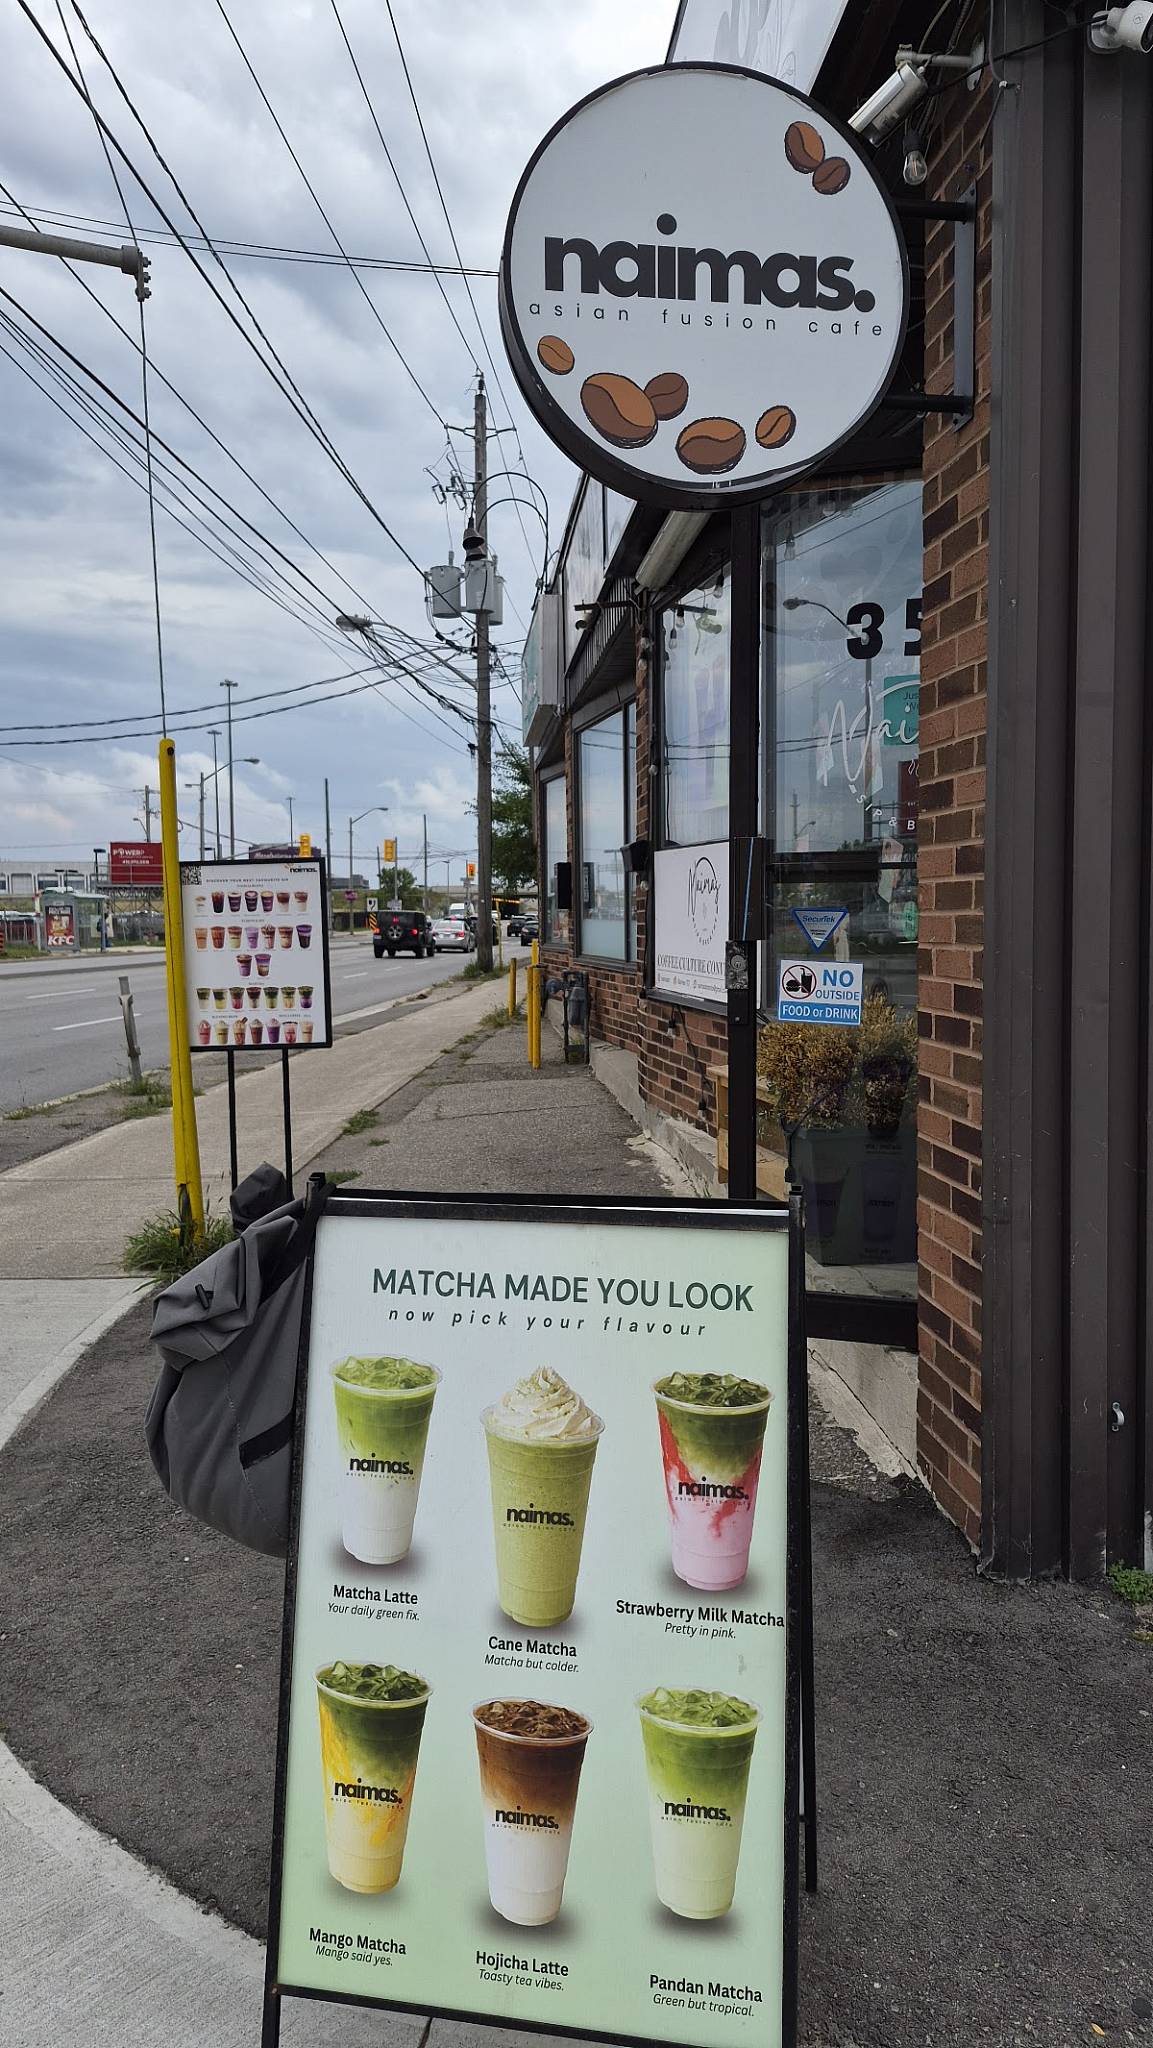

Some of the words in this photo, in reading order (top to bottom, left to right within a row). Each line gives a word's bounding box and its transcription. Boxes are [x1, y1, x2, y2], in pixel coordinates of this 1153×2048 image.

[544, 213, 876, 313] naimas.
[529, 302, 630, 321] asian
[662, 309, 777, 331] fusion
[808, 319, 882, 336] cafe
[48, 936, 74, 946] KFC
[822, 969, 854, 987] NO
[815, 990, 860, 1000] OUTSIDE
[782, 1004, 811, 1017] FOOD
[812, 1009, 824, 1017] or
[825, 1007, 858, 1019] DRINK
[373, 1268, 496, 1299] MATCHA
[504, 1274, 588, 1302] MADE
[597, 1277, 659, 1307] YOU
[669, 1281, 754, 1311] LOOK
[388, 1308, 435, 1323] now
[452, 1309, 507, 1326] pick
[526, 1313, 585, 1331] your
[603, 1316, 706, 1336] flavour
[350, 1453, 413, 1474] naimas.
[679, 1476, 749, 1500] naimas.
[507, 1503, 574, 1526] naimas.
[333, 1585, 381, 1602] Matcha
[384, 1589, 418, 1605] Latte
[328, 1603, 349, 1614] Your
[351, 1605, 375, 1619] daily
[376, 1608, 404, 1620] green
[406, 1608, 420, 1621] fix.
[616, 1600, 694, 1621] Strawberry
[698, 1607, 727, 1622] Milk
[731, 1610, 785, 1627] Matcha
[664, 1622, 697, 1637] Pretty
[699, 1625, 709, 1636] in
[711, 1626, 736, 1640] pink.
[488, 1636, 523, 1652] Cane
[526, 1639, 577, 1657] Matcha
[484, 1654, 524, 1668] Matcha
[526, 1658, 543, 1670] but
[545, 1660, 579, 1673] colder.
[335, 1778, 403, 1804] naimas.
[496, 1806, 559, 1829] naimas.
[665, 1798, 731, 1822] naimas.
[309, 1928, 353, 1949] Mango
[356, 1934, 406, 1954] Matcha
[315, 1945, 349, 1961] Mango
[351, 1950, 372, 1963] said
[373, 1955, 393, 1966] yes.
[476, 1950, 528, 1971] Hojicha
[532, 1958, 569, 1976] Latte
[479, 1968, 513, 1986] Toasty
[515, 1974, 532, 1986] tea
[534, 1976, 564, 1991] vibes.
[650, 1974, 704, 1995] Pandan
[708, 1982, 762, 2002] Matcha
[653, 1993, 685, 2008] Green
[687, 1997, 706, 2010] but
[709, 2000, 754, 2017] tropical.
